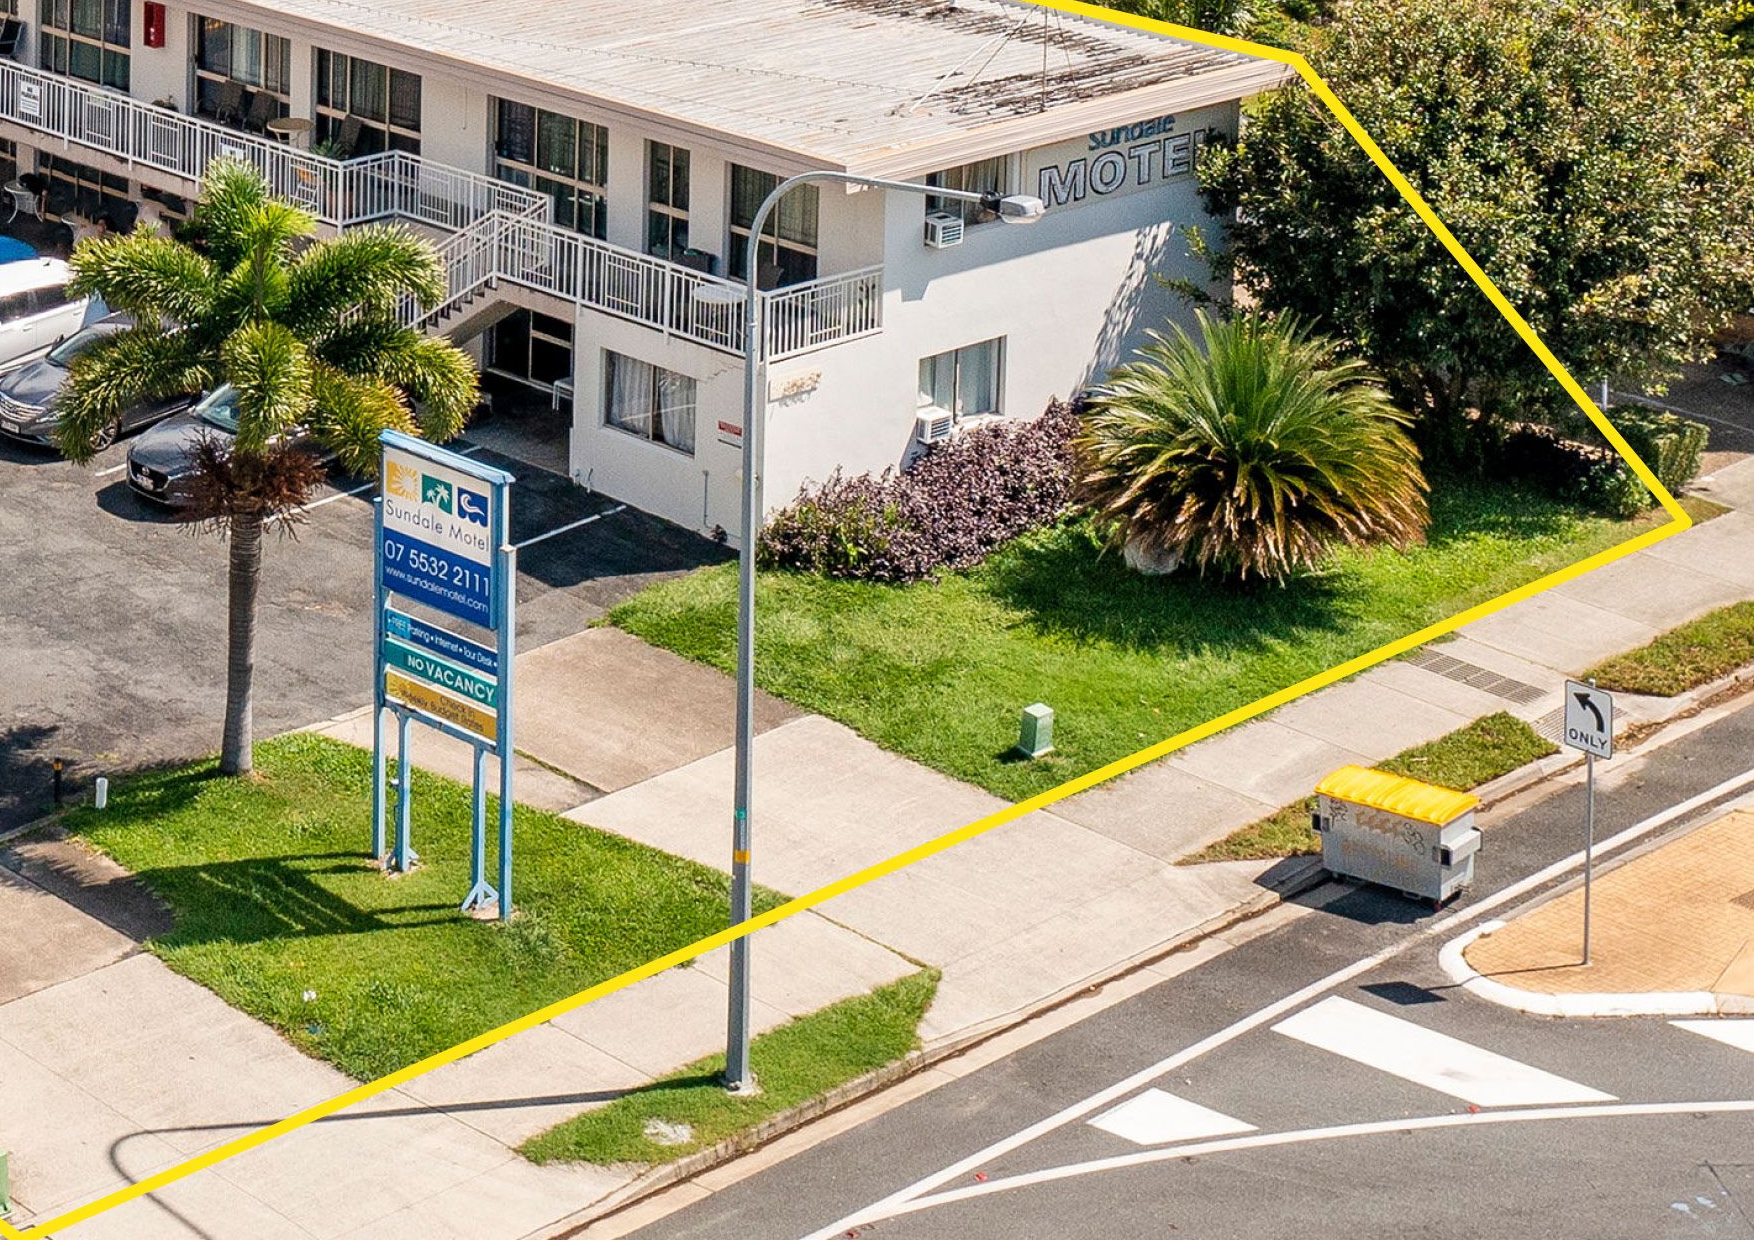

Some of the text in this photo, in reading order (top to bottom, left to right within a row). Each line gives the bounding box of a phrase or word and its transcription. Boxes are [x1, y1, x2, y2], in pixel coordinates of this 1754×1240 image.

[386, 499, 490, 552] Sundale Motel
[385, 539, 489, 597] 07 5532 2111
[408, 655, 494, 702] NO VACANCY
[1569, 728, 1607, 750] ONLY
